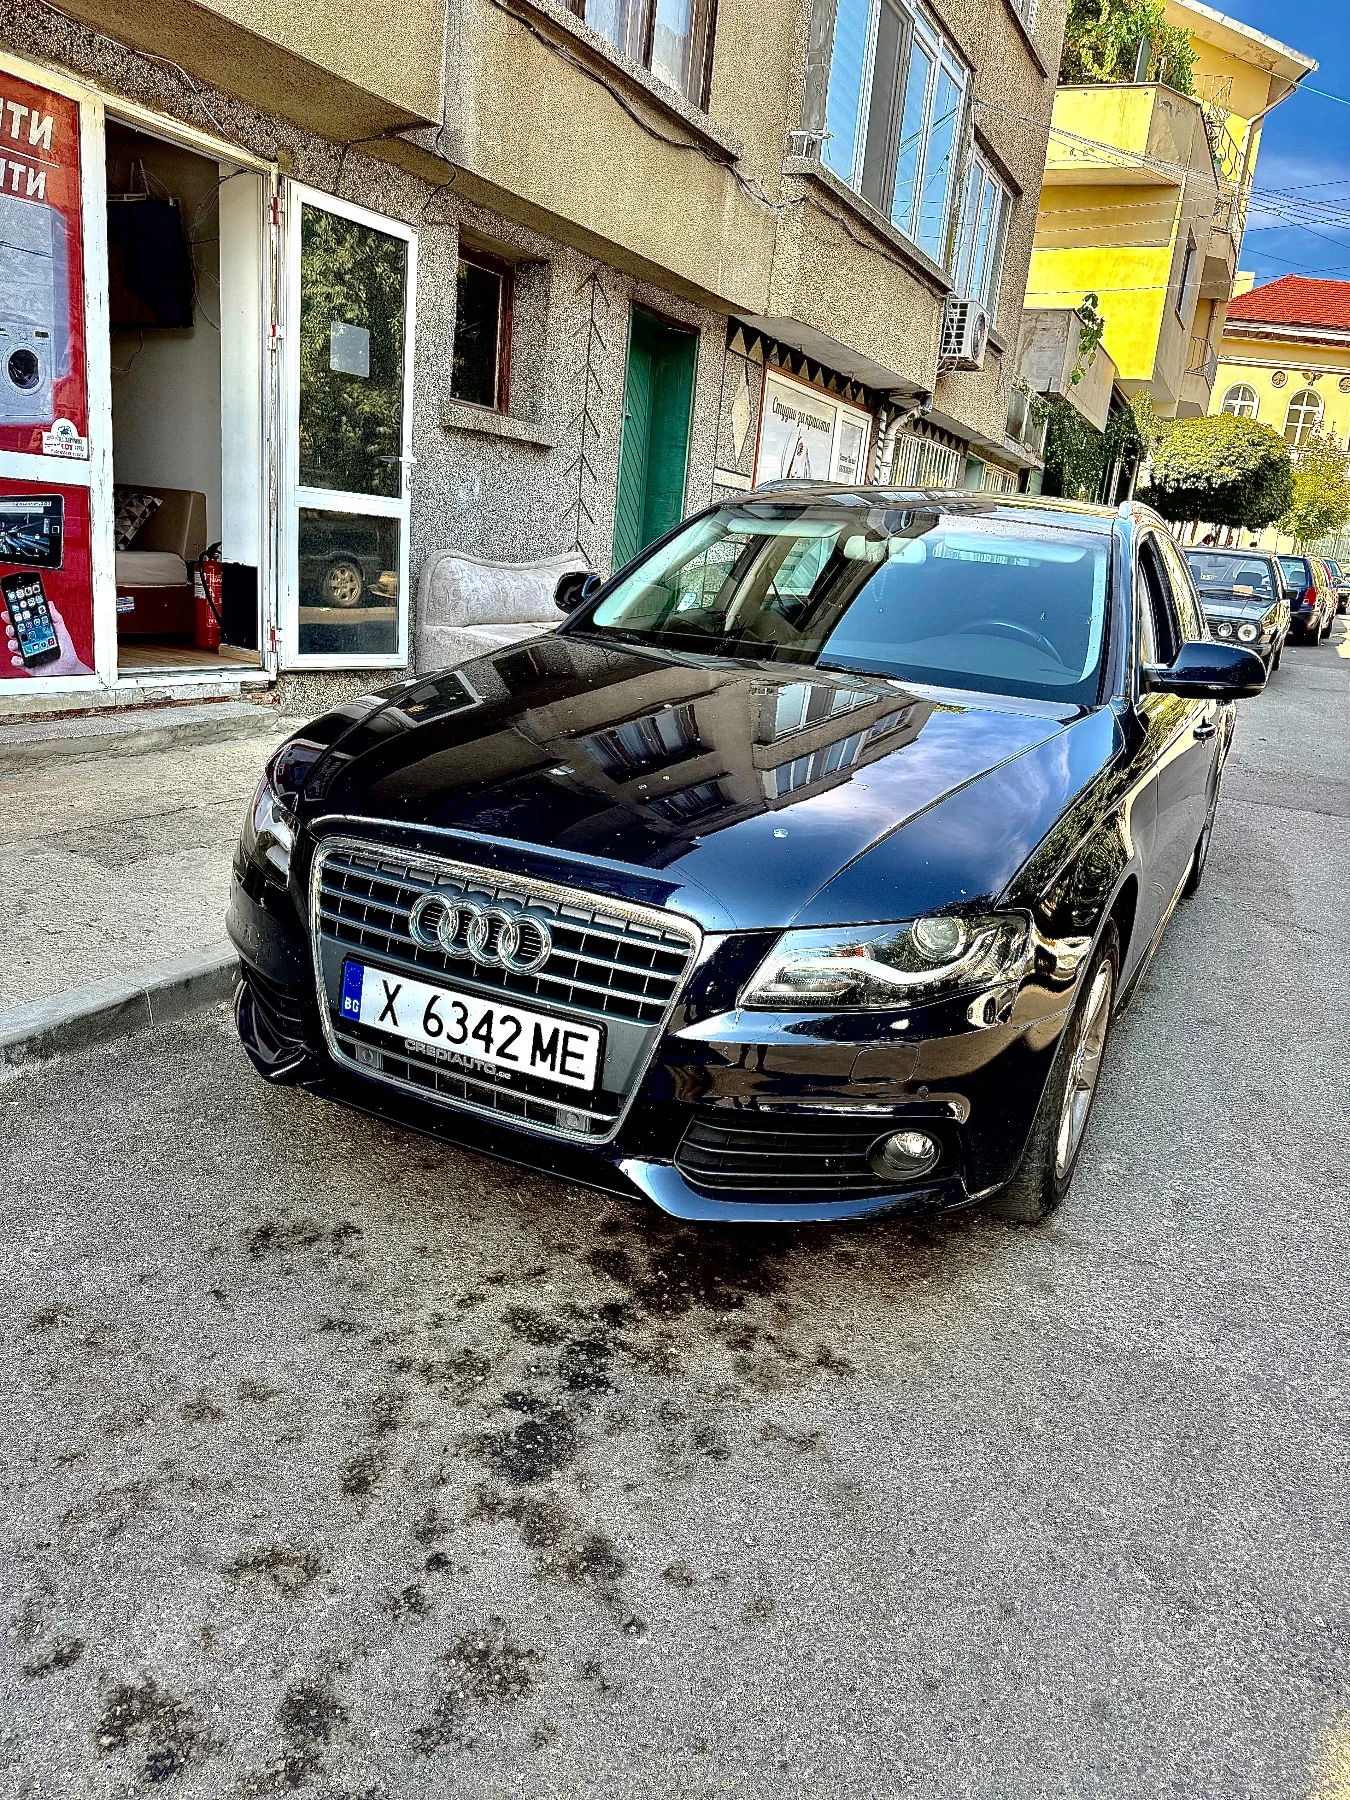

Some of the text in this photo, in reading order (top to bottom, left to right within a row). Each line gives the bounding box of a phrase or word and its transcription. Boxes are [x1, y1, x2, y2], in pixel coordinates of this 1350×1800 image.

[0, 97, 54, 151] ТИ
[772, 396, 796, 423] Студио
[805, 412, 831, 434] красота
[344, 996, 360, 1013] BG
[378, 978, 403, 1028] X
